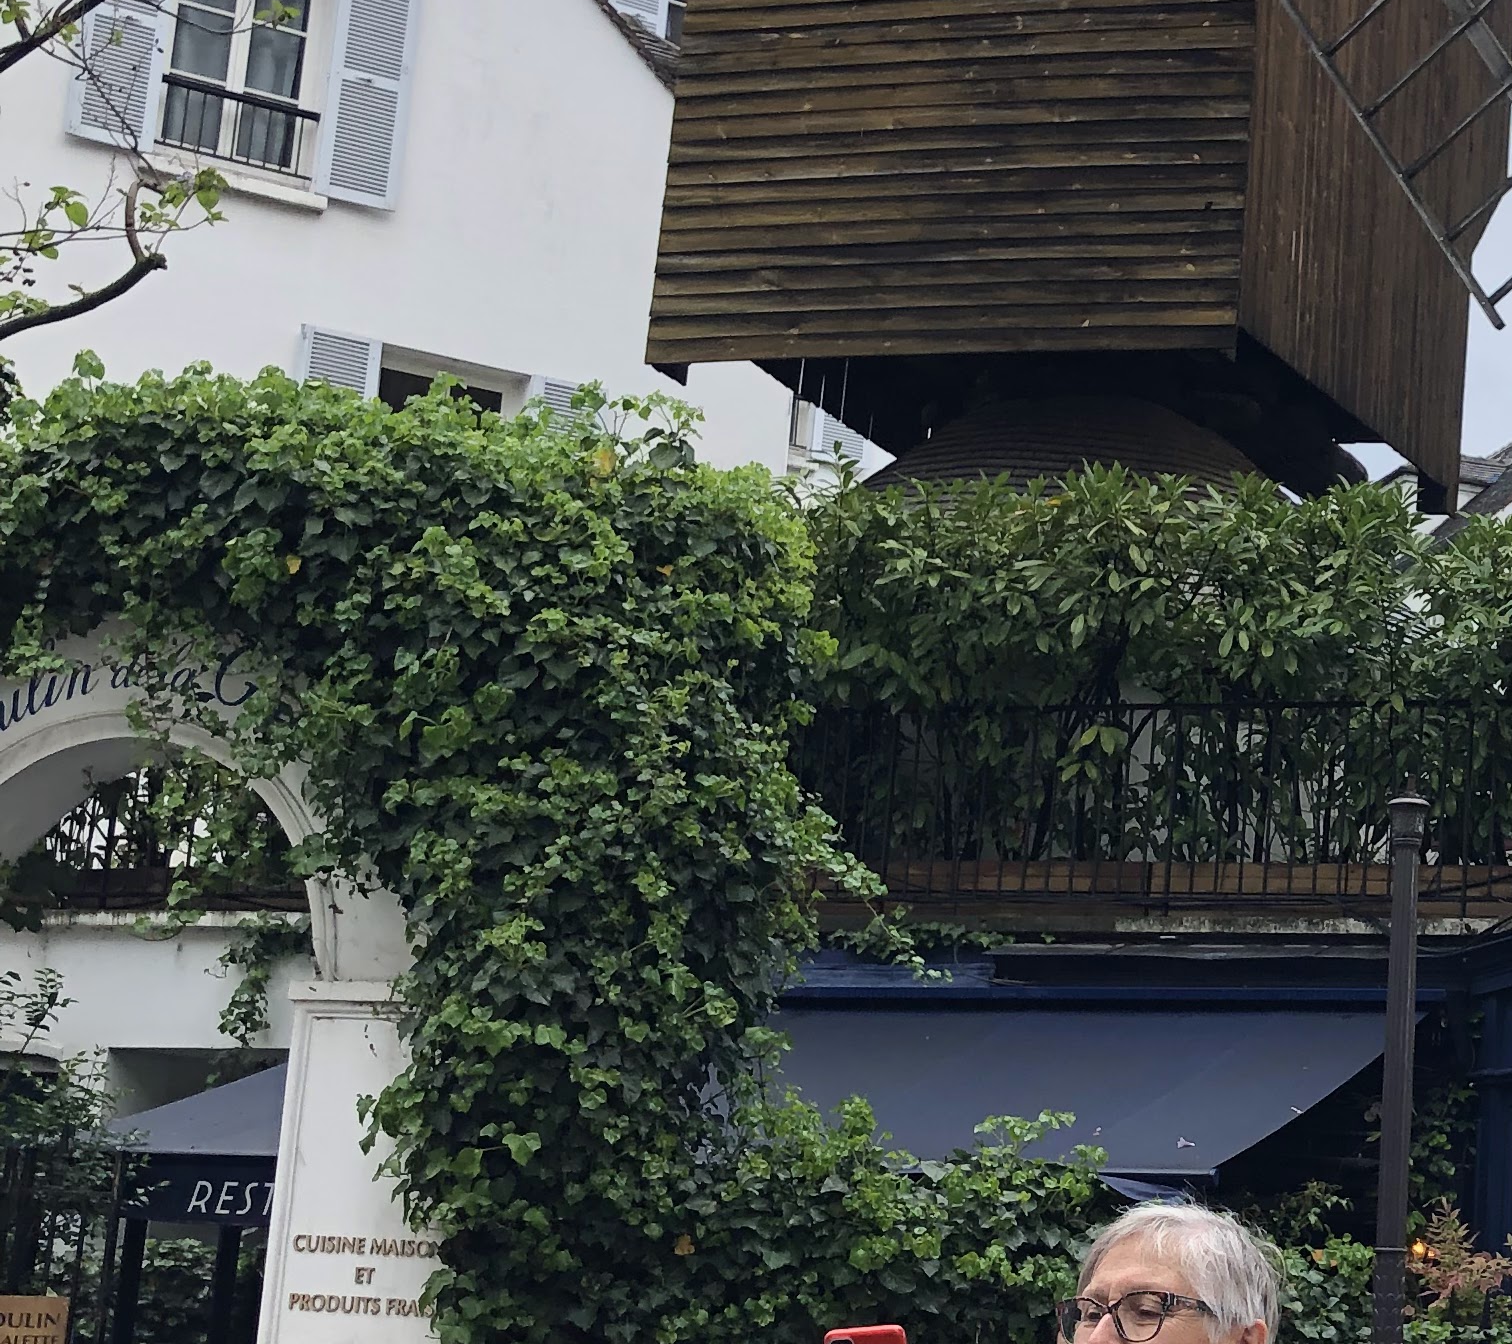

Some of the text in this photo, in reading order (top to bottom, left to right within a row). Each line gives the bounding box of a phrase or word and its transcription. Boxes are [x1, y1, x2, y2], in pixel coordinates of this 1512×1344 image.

[293, 1234, 366, 1255] CUISINE
[354, 1266, 376, 1285] ET
[288, 1292, 382, 1316] PRODUITS
